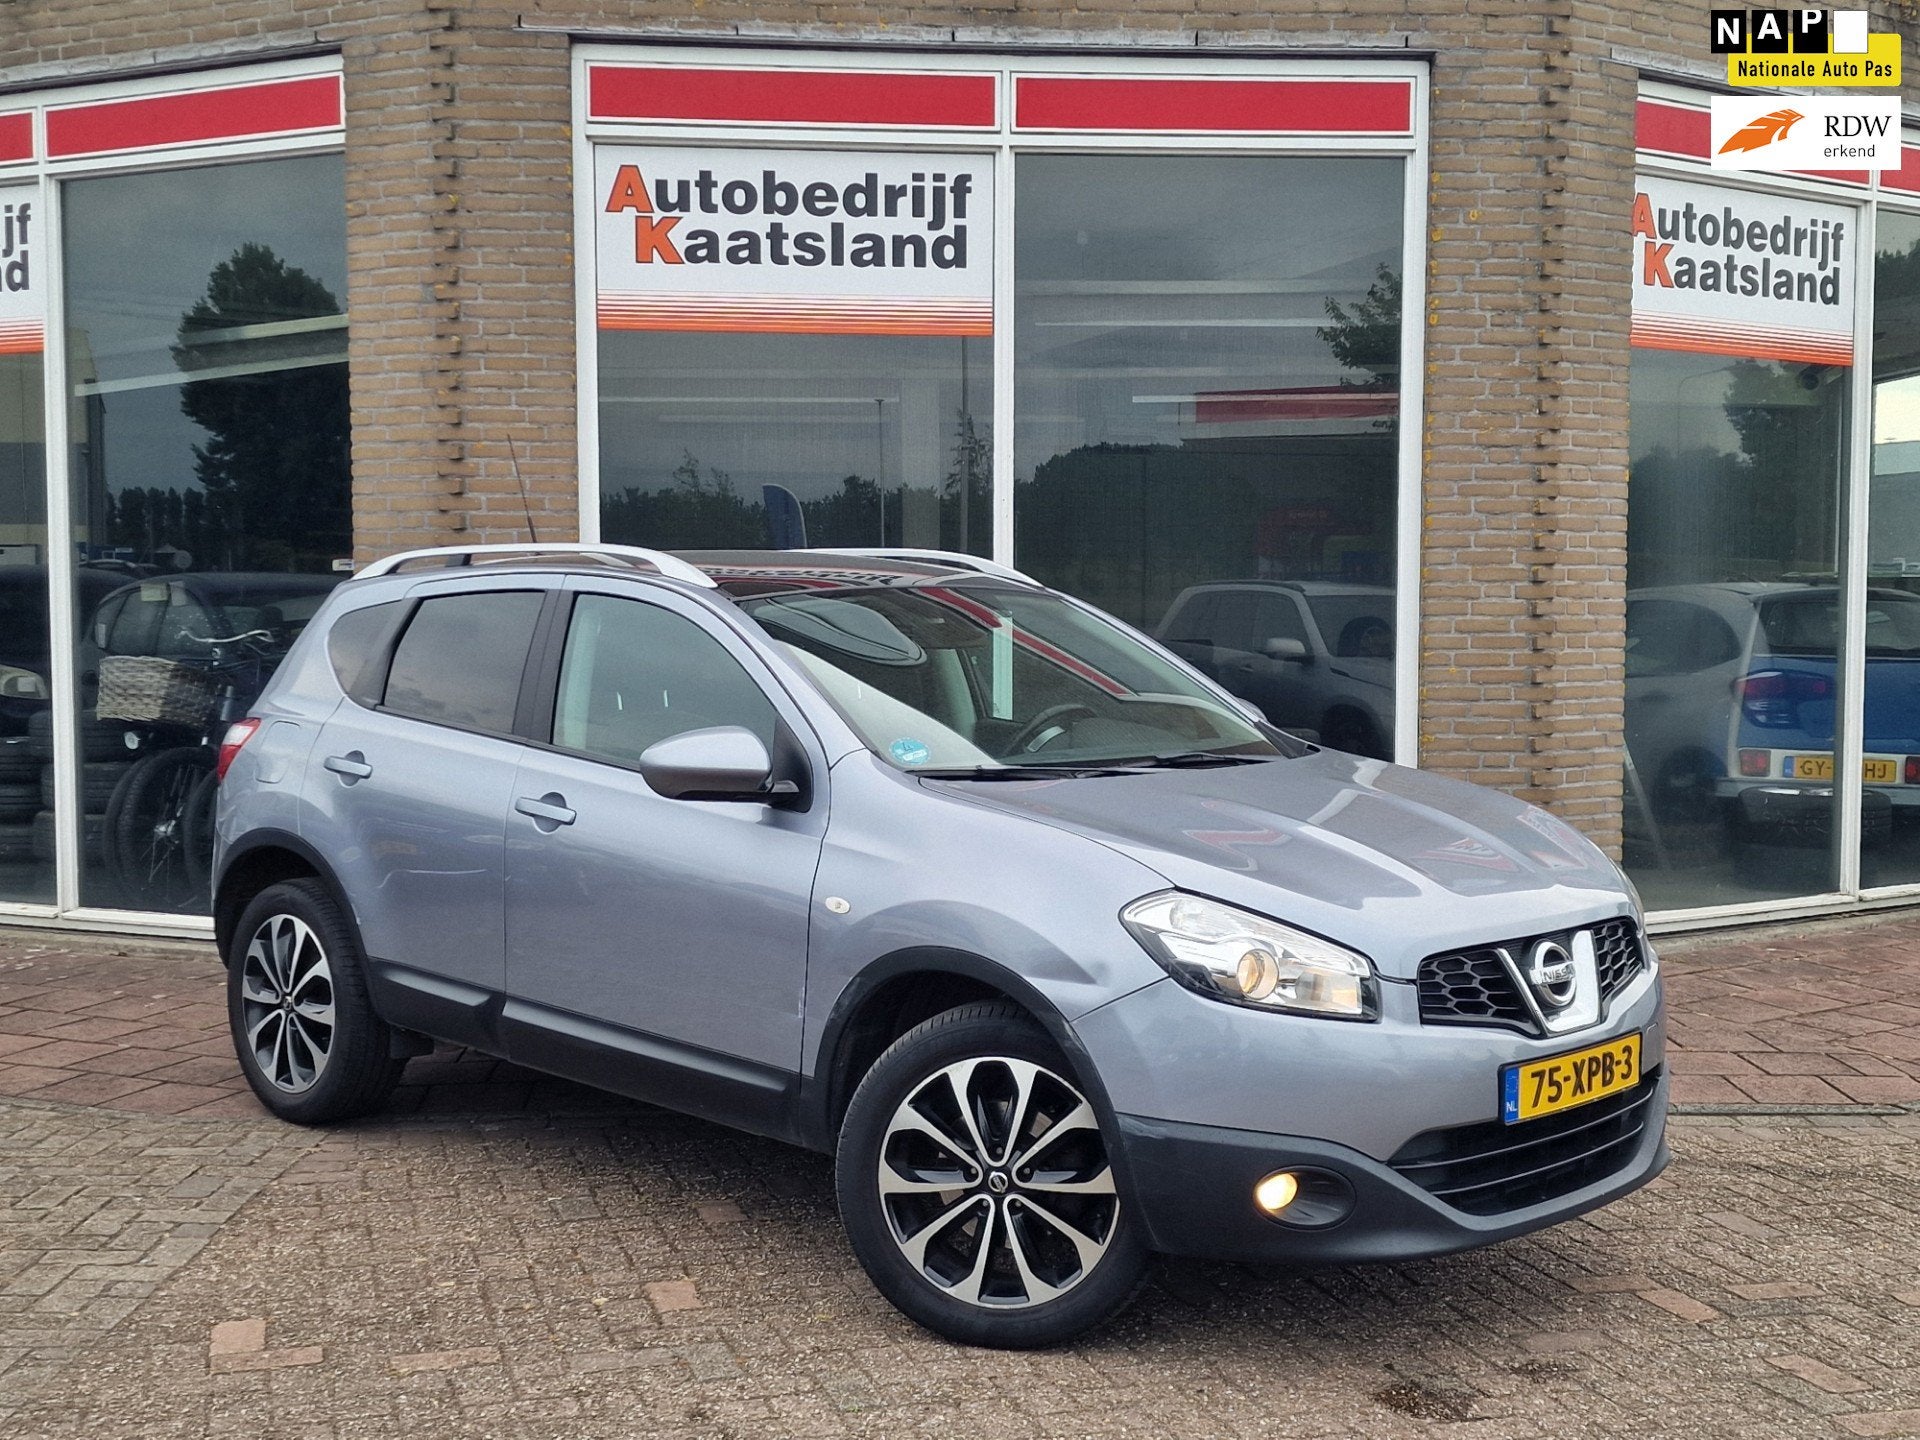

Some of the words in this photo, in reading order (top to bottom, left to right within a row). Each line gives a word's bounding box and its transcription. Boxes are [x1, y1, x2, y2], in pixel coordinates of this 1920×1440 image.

[605, 164, 972, 231] Autobedrijf
[634, 215, 967, 269] Kaatsland
[1631, 192, 1844, 271] Autobedrijf
[1643, 240, 1840, 305] Kaatsland
[1505, 1101, 1517, 1112] NL
[1531, 1045, 1633, 1108] 75-XPB-3
